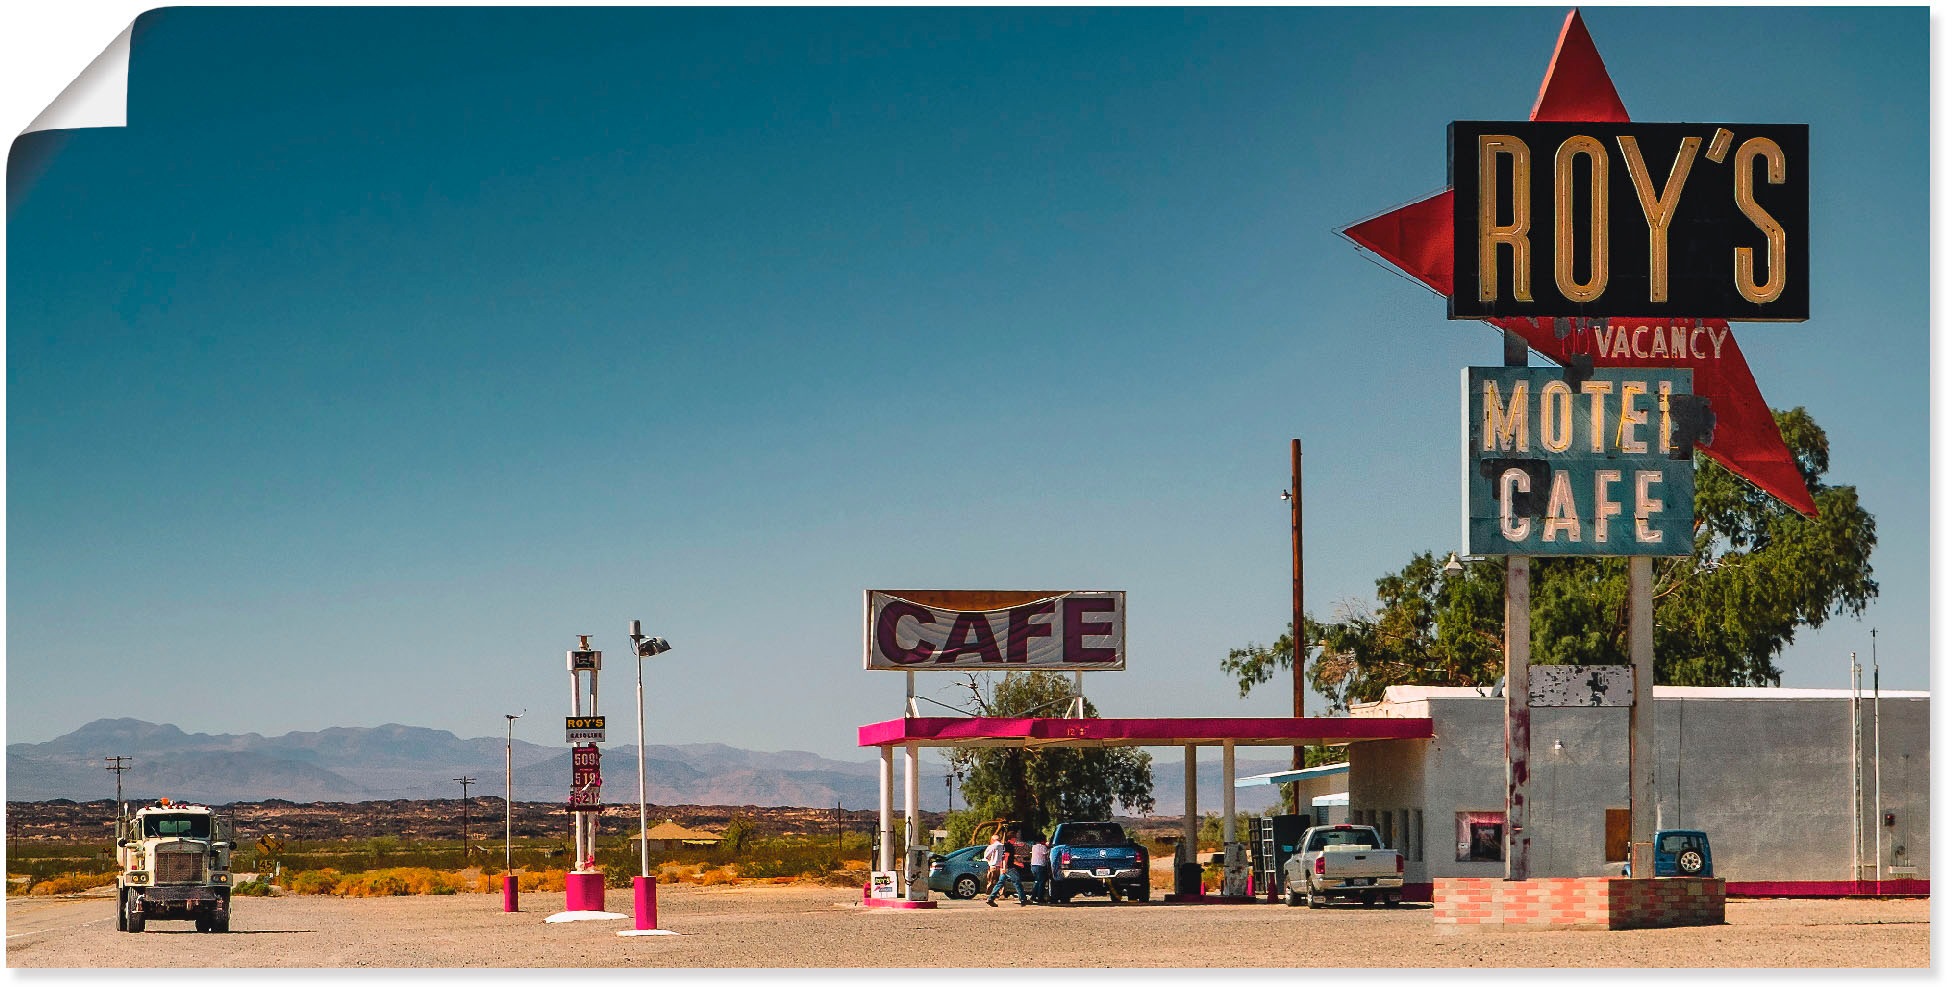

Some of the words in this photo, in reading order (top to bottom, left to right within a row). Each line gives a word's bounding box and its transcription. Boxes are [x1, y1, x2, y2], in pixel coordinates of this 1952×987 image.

[1478, 127, 1786, 304] ROY'S
[1593, 325, 1729, 359] VACANCY
[1482, 379, 1679, 454] MOTEL
[1500, 467, 1664, 543] CAFE
[876, 597, 1117, 664] CAFE
[567, 719, 604, 728] ROY'S
[260, 859, 273, 869] 45
